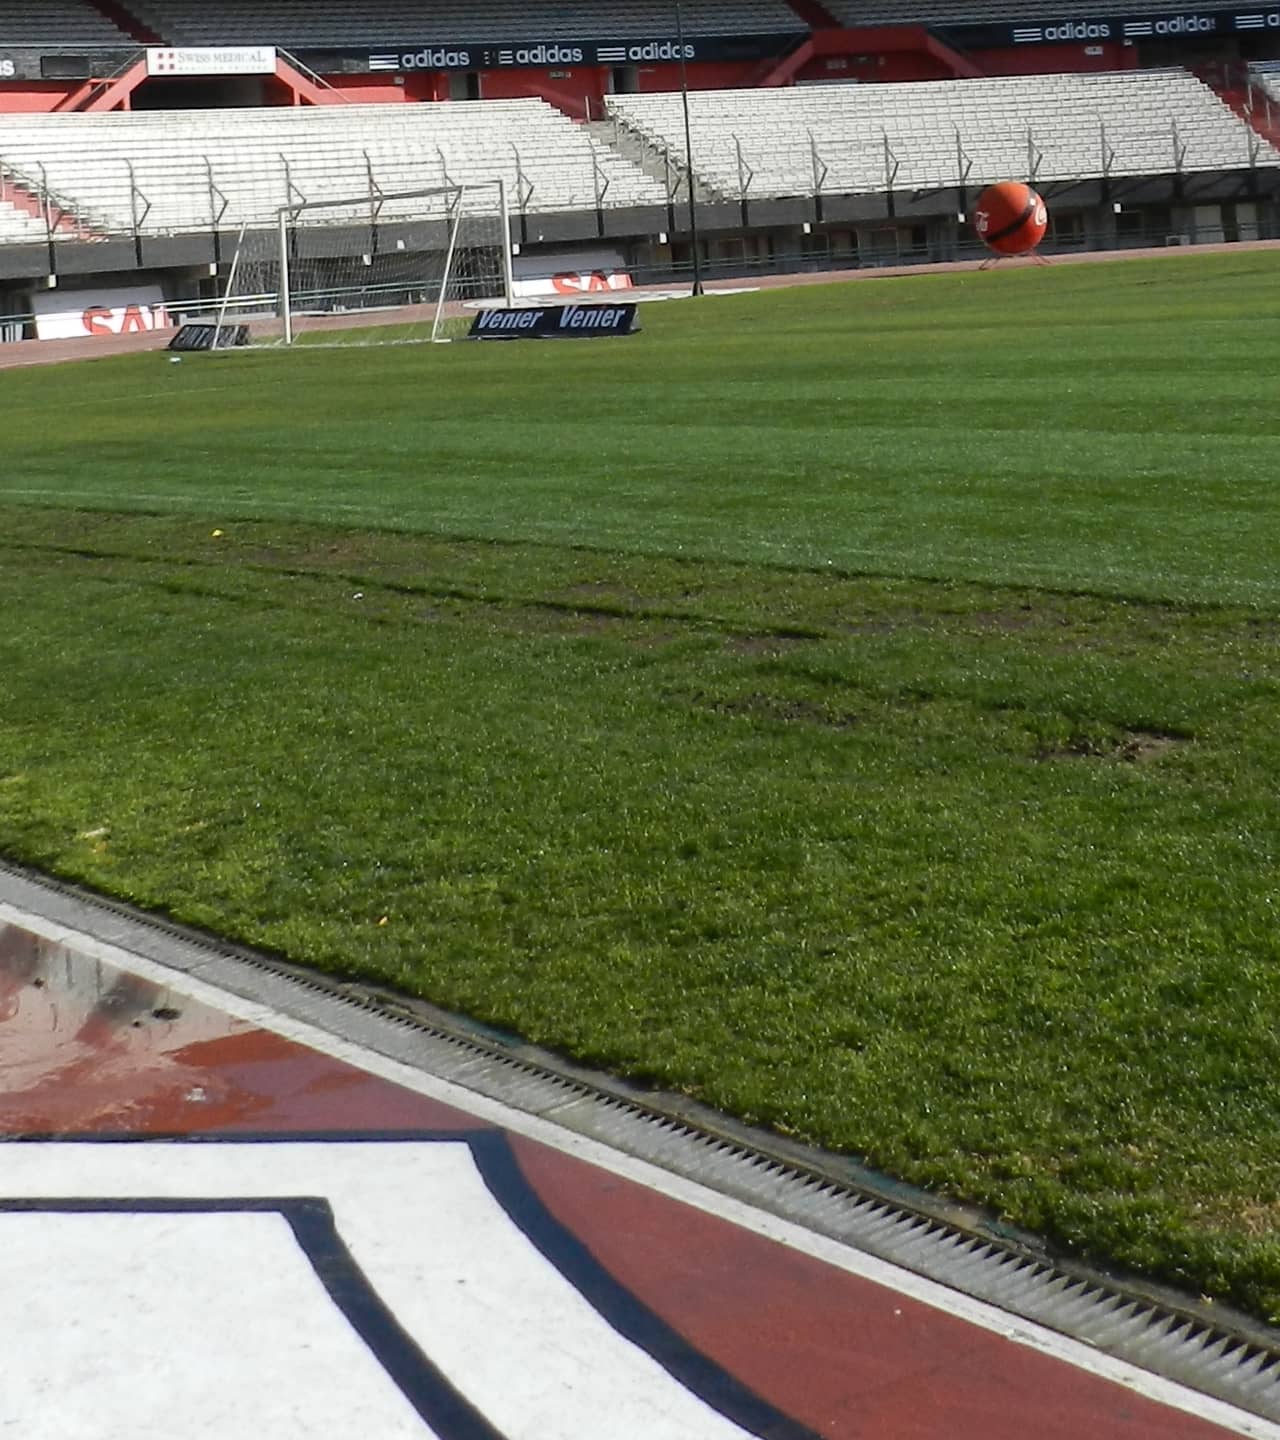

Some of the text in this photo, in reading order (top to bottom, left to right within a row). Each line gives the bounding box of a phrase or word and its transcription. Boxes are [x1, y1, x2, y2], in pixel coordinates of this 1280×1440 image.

[1045, 21, 1110, 40] adidas
[402, 47, 470, 68] adidas
[516, 44, 583, 65] adidas
[629, 40, 695, 60] adidas
[477, 305, 626, 329] Venier Venier
